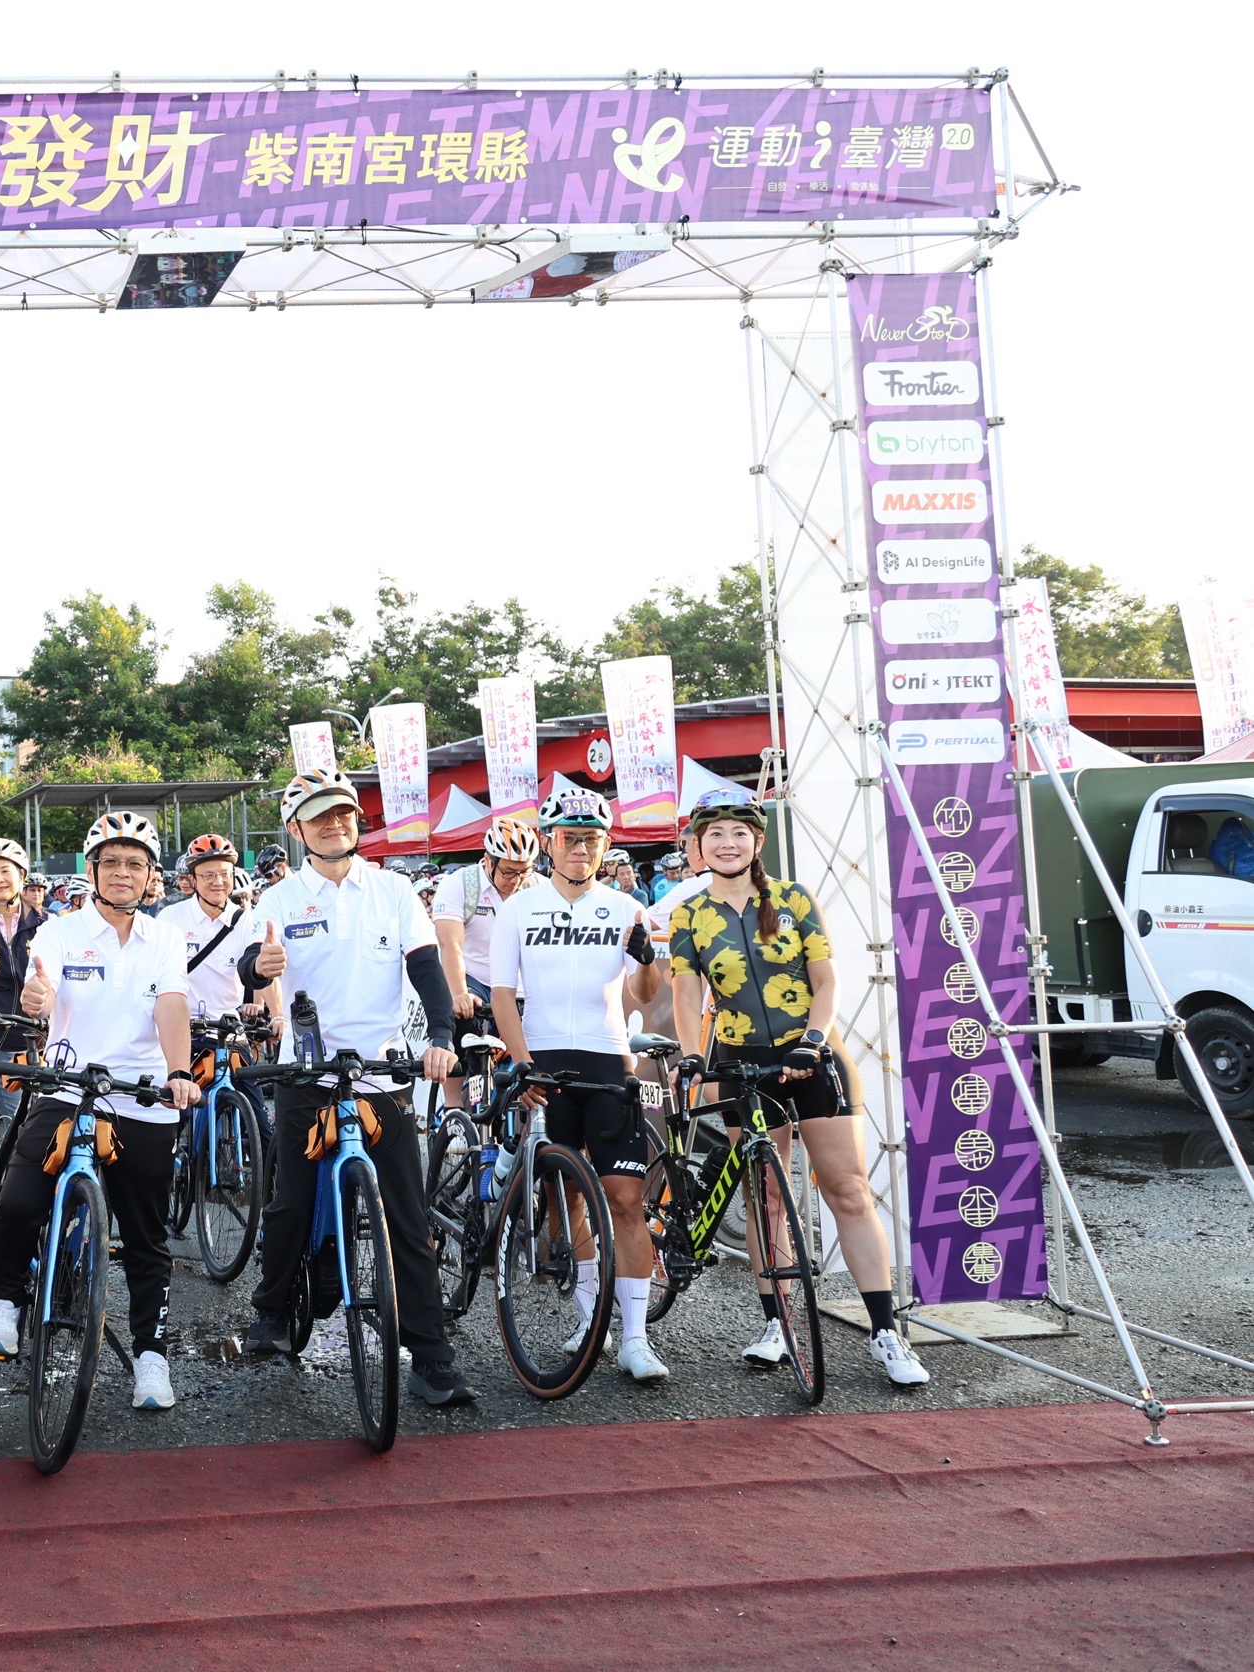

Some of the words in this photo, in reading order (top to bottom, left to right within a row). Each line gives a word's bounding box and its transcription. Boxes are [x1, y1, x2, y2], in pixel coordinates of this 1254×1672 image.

[945, 127, 971, 146] 2.0
[242, 129, 530, 186] 紫南宮環縣
[878, 370, 965, 398] Frontier
[905, 434, 975, 455] bryton
[882, 493, 976, 511] MAXXIS
[905, 557, 918, 568] AI
[922, 556, 985, 570] DesignLife
[946, 675, 994, 691] JTEKT
[935, 736, 998, 746] PERTUAL
[565, 800, 597, 815] 2965
[1164, 905, 1204, 914] 柴油小霸王
[639, 1084, 660, 1105] 2987
[690, 1141, 741, 1248] SCOTT
